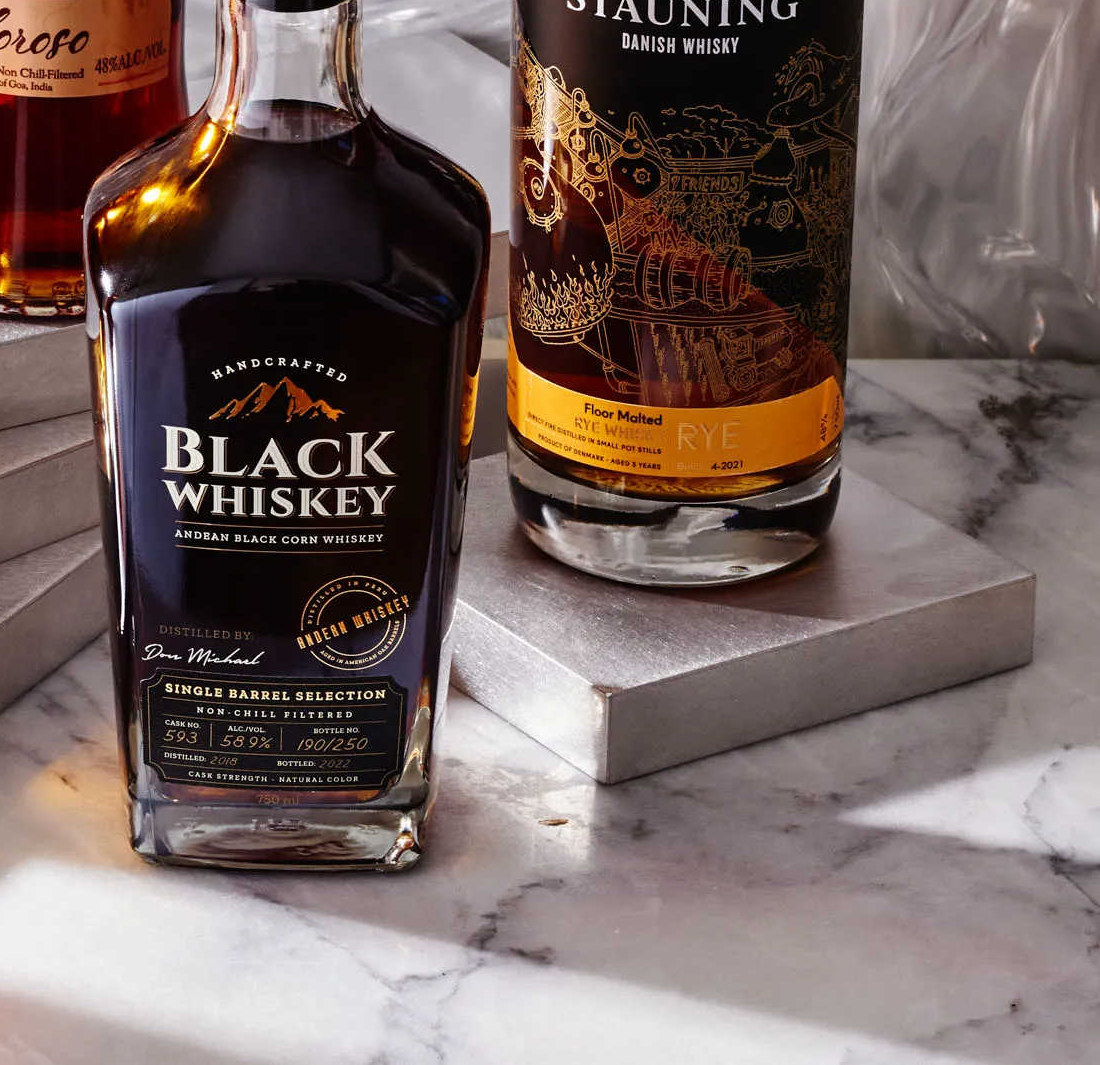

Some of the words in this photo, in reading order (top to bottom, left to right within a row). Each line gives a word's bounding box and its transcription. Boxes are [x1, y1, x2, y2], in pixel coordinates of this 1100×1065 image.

[622, 32, 676, 54] DANISH
[683, 36, 739, 54] WHISKY
[20, 68, 85, 80] Chill-Filtered
[9, 79, 28, 91] Goa,
[30, 81, 53, 92] India
[681, 175, 740, 192] FRIENDS
[211, 357, 348, 383] HANDCRAFTED
[584, 402, 614, 419] Floor
[618, 410, 663, 426] Malted
[574, 417, 600, 434] RYE
[557, 427, 587, 442] DISTILLED
[596, 439, 619, 450] SMALL
[621, 444, 636, 452] POT
[638, 447, 662, 455] STILLS
[678, 422, 741, 450] RYE
[161, 425, 398, 480] BLACK
[538, 433, 562, 449] PRODUCT
[574, 448, 605, 461] DENMARK
[610, 458, 630, 466] AGED
[711, 460, 743, 470] 4-2021
[161, 479, 397, 518] WHISKEY
[175, 529, 230, 542] ANDEAN
[234, 534, 277, 544] BLACK
[281, 535, 318, 545] CORN
[322, 533, 384, 544] WHISKEY
[307, 583, 342, 625] DISTILLED
[365, 582, 388, 596] PERU
[296, 621, 348, 650] ANDEAN
[352, 594, 410, 629] WHISKEY
[159, 625, 231, 640] DISTILLED
[234, 631, 255, 641] BY:
[344, 653, 378, 665] AMERICAN
[165, 683, 223, 698] SINGLE
[228, 689, 291, 701] BARREL
[295, 689, 386, 701] SELECTION
[196, 706, 277, 718] NON-CHILL
[284, 711, 354, 719] FILTERED
[164, 719, 185, 728] CASK
[187, 721, 202, 729] NO.
[227, 725, 267, 733] ALC./VOL.
[163, 729, 198, 744] 593
[297, 737, 369, 752] 190/250
[164, 751, 207, 762] DISTILLED:
[209, 756, 238, 766] 2018
[319, 759, 351, 769] 2022
[188, 771, 213, 779] CASK
[216, 773, 268, 782] STRENGTH
[256, 793, 280, 805] 750
